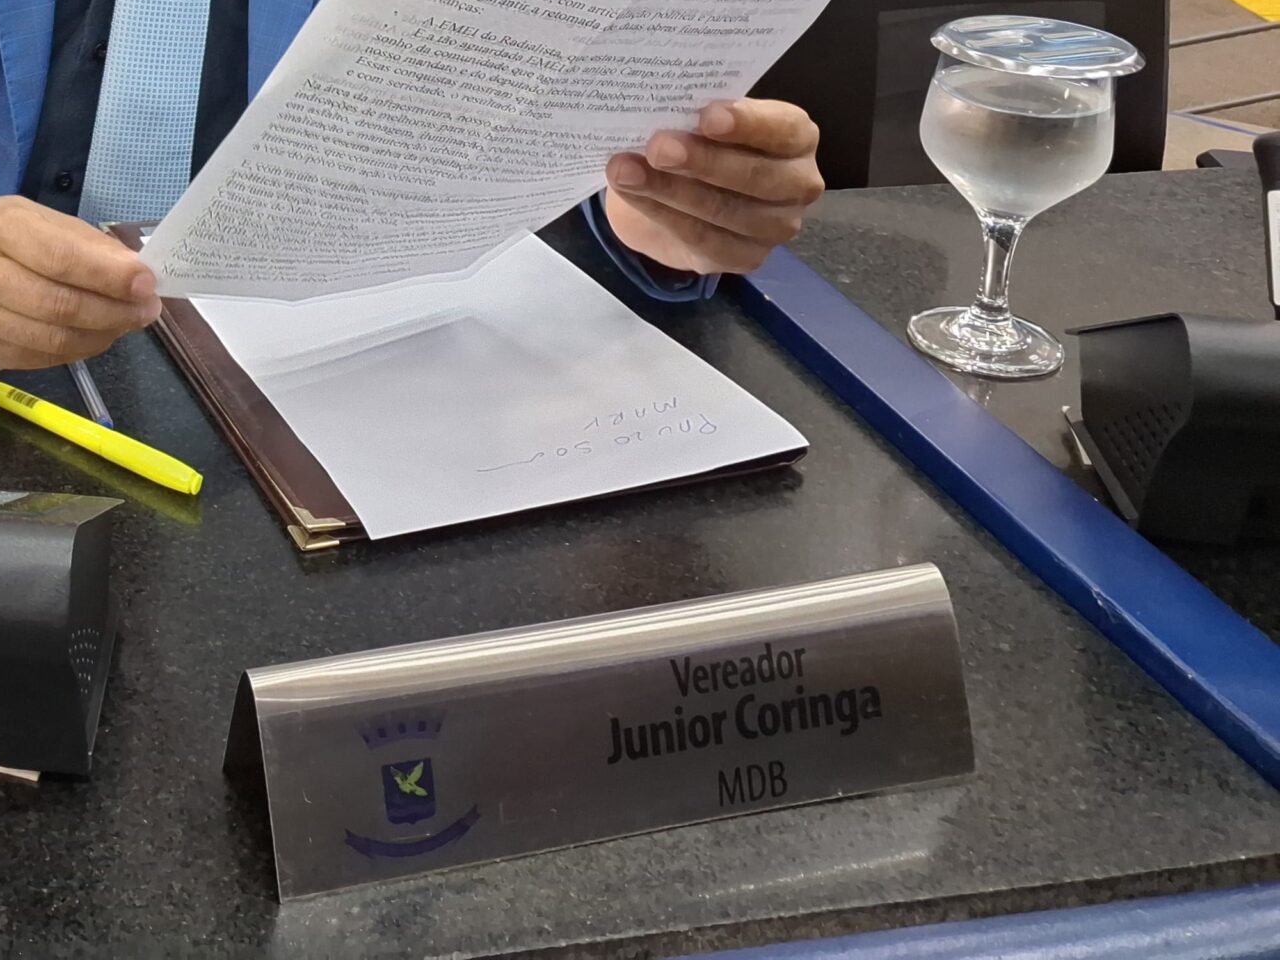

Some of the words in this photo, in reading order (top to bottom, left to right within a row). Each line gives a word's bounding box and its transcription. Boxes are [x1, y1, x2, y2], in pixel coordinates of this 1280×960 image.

[422, 16, 433, 27] A
[438, 20, 479, 36] EMEI
[480, 28, 497, 41] do
[500, 33, 563, 60] Radialista,
[567, 52, 589, 63] que
[590, 52, 624, 63] estava
[531, 5, 539, 13] a
[540, 7, 600, 30] retomada
[603, 20, 619, 32] de
[364, 46, 401, 61] nosso
[403, 55, 458, 73] mandato
[459, 67, 467, 75] e
[470, 66, 487, 79] do
[489, 71, 544, 94] deputado
[374, 34, 413, 50] sonho
[415, 41, 431, 54] da
[433, 48, 509, 71] comunidade
[510, 65, 534, 77] que
[536, 72, 569, 84] agora
[412, 28, 424, 38] E
[426, 32, 434, 41] a
[438, 32, 457, 46] tão
[460, 40, 523, 61] aguardada
[526, 54, 565, 72] EMEI
[620, 66, 658, 81] Campo
[304, 78, 322, 90] Na
[323, 81, 350, 97] área
[353, 89, 368, 102] da
[455, 115, 491, 127] nosso
[346, 69, 355, 77] e
[357, 71, 384, 84] com
[386, 78, 445, 99] seriedade,
[450, 91, 459, 99] o
[461, 93, 517, 113] resultado
[356, 54, 391, 71] Essas
[393, 65, 459, 86] conquistas
[460, 80, 513, 99] mostram
[543, 99, 584, 111] quando
[285, 102, 305, 112] em
[354, 115, 414, 140] drenagem,
[293, 87, 359, 112] indicações
[361, 103, 376, 115] de
[379, 110, 436, 129] melhorias
[438, 124, 465, 135] para
[467, 130, 481, 138] os
[346, 128, 354, 136] e
[323, 148, 342, 159] que
[403, 151, 417, 162] da
[670, 642, 806, 697] Vereador
[607, 705, 727, 765] Junior
[735, 685, 882, 739] Coringa
[718, 760, 788, 807] MDB
